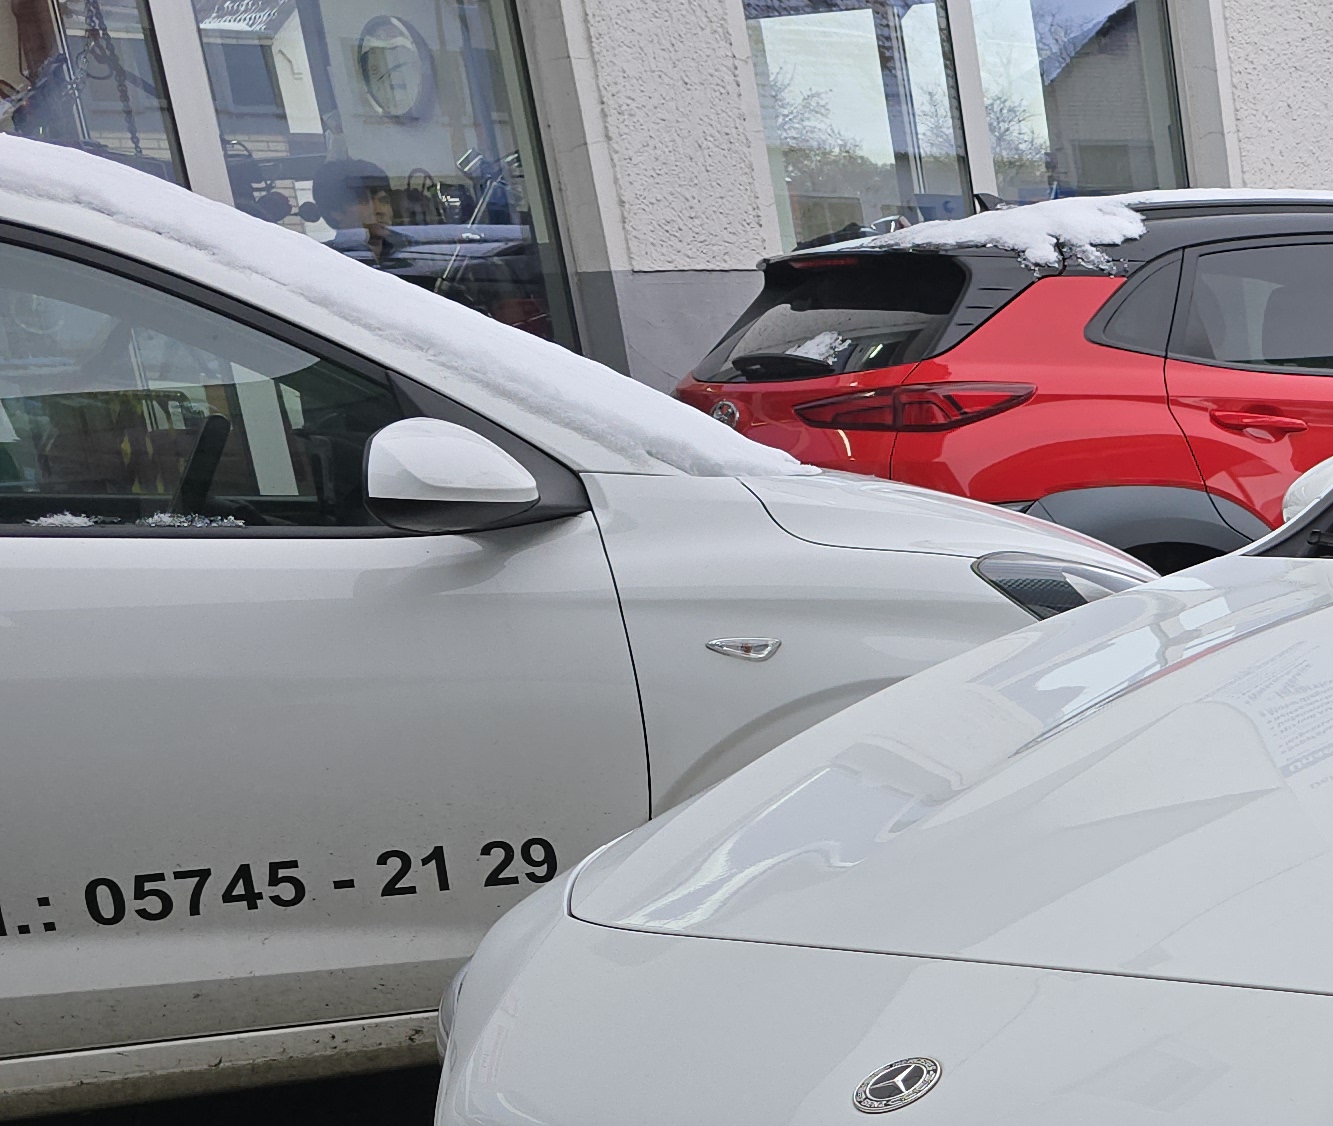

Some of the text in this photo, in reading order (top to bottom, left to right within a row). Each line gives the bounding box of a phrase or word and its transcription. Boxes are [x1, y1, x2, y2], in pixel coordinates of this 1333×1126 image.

[84, 859, 305, 926] 05745
[376, 845, 452, 897] 21
[480, 837, 558, 887] 29
